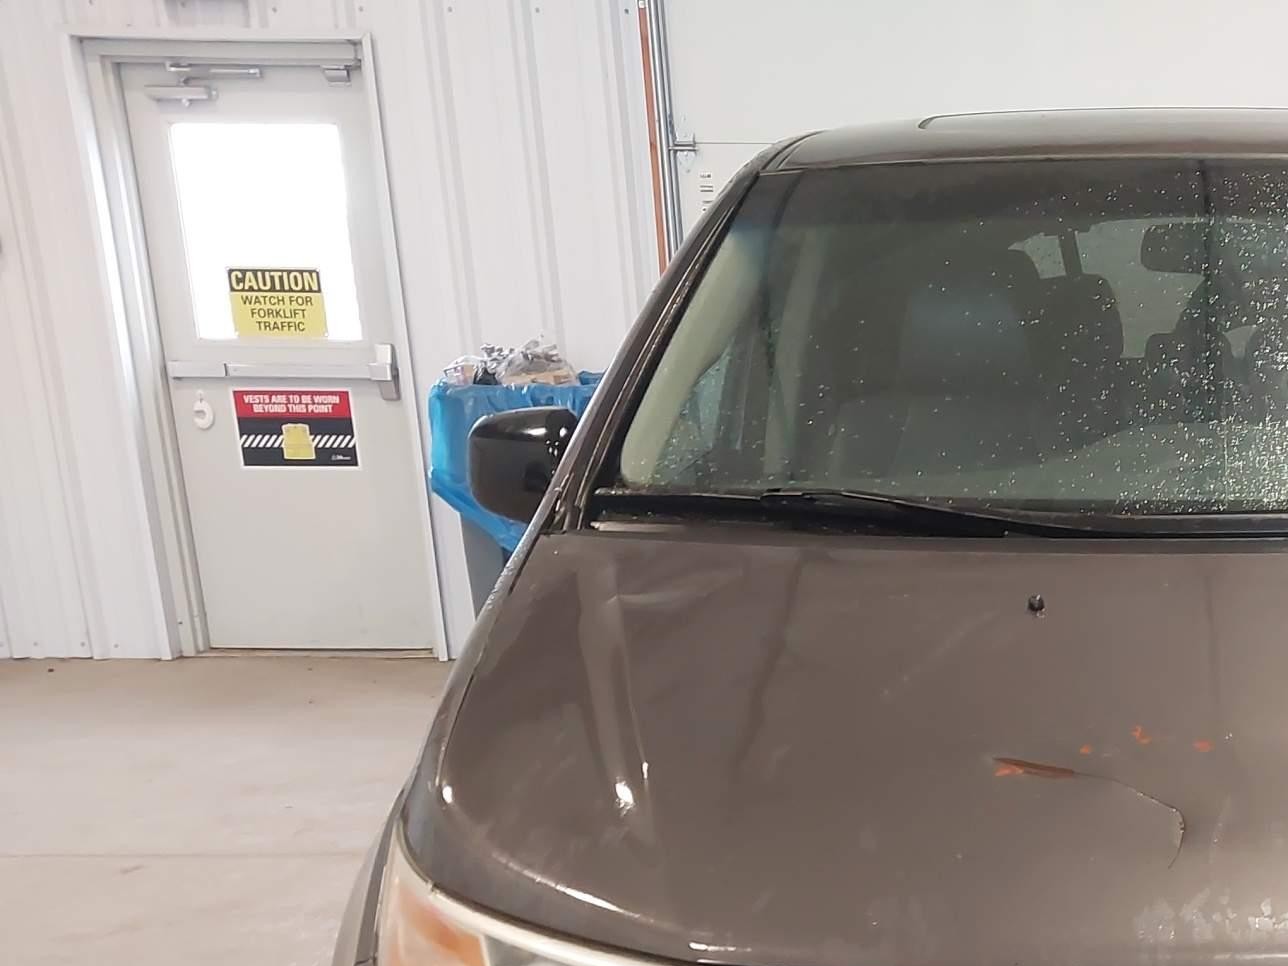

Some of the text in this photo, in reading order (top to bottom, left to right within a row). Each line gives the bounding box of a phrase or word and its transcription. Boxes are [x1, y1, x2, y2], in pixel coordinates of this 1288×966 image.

[230, 271, 318, 291] CAUTION
[241, 295, 313, 306] WATCH FOR
[251, 308, 306, 319] FORKLIFT
[256, 321, 306, 332] TRAFFIC
[243, 395, 340, 403] VESTS ARE TO BE WORN
[253, 404, 333, 413] BEYOND THIS POINT
